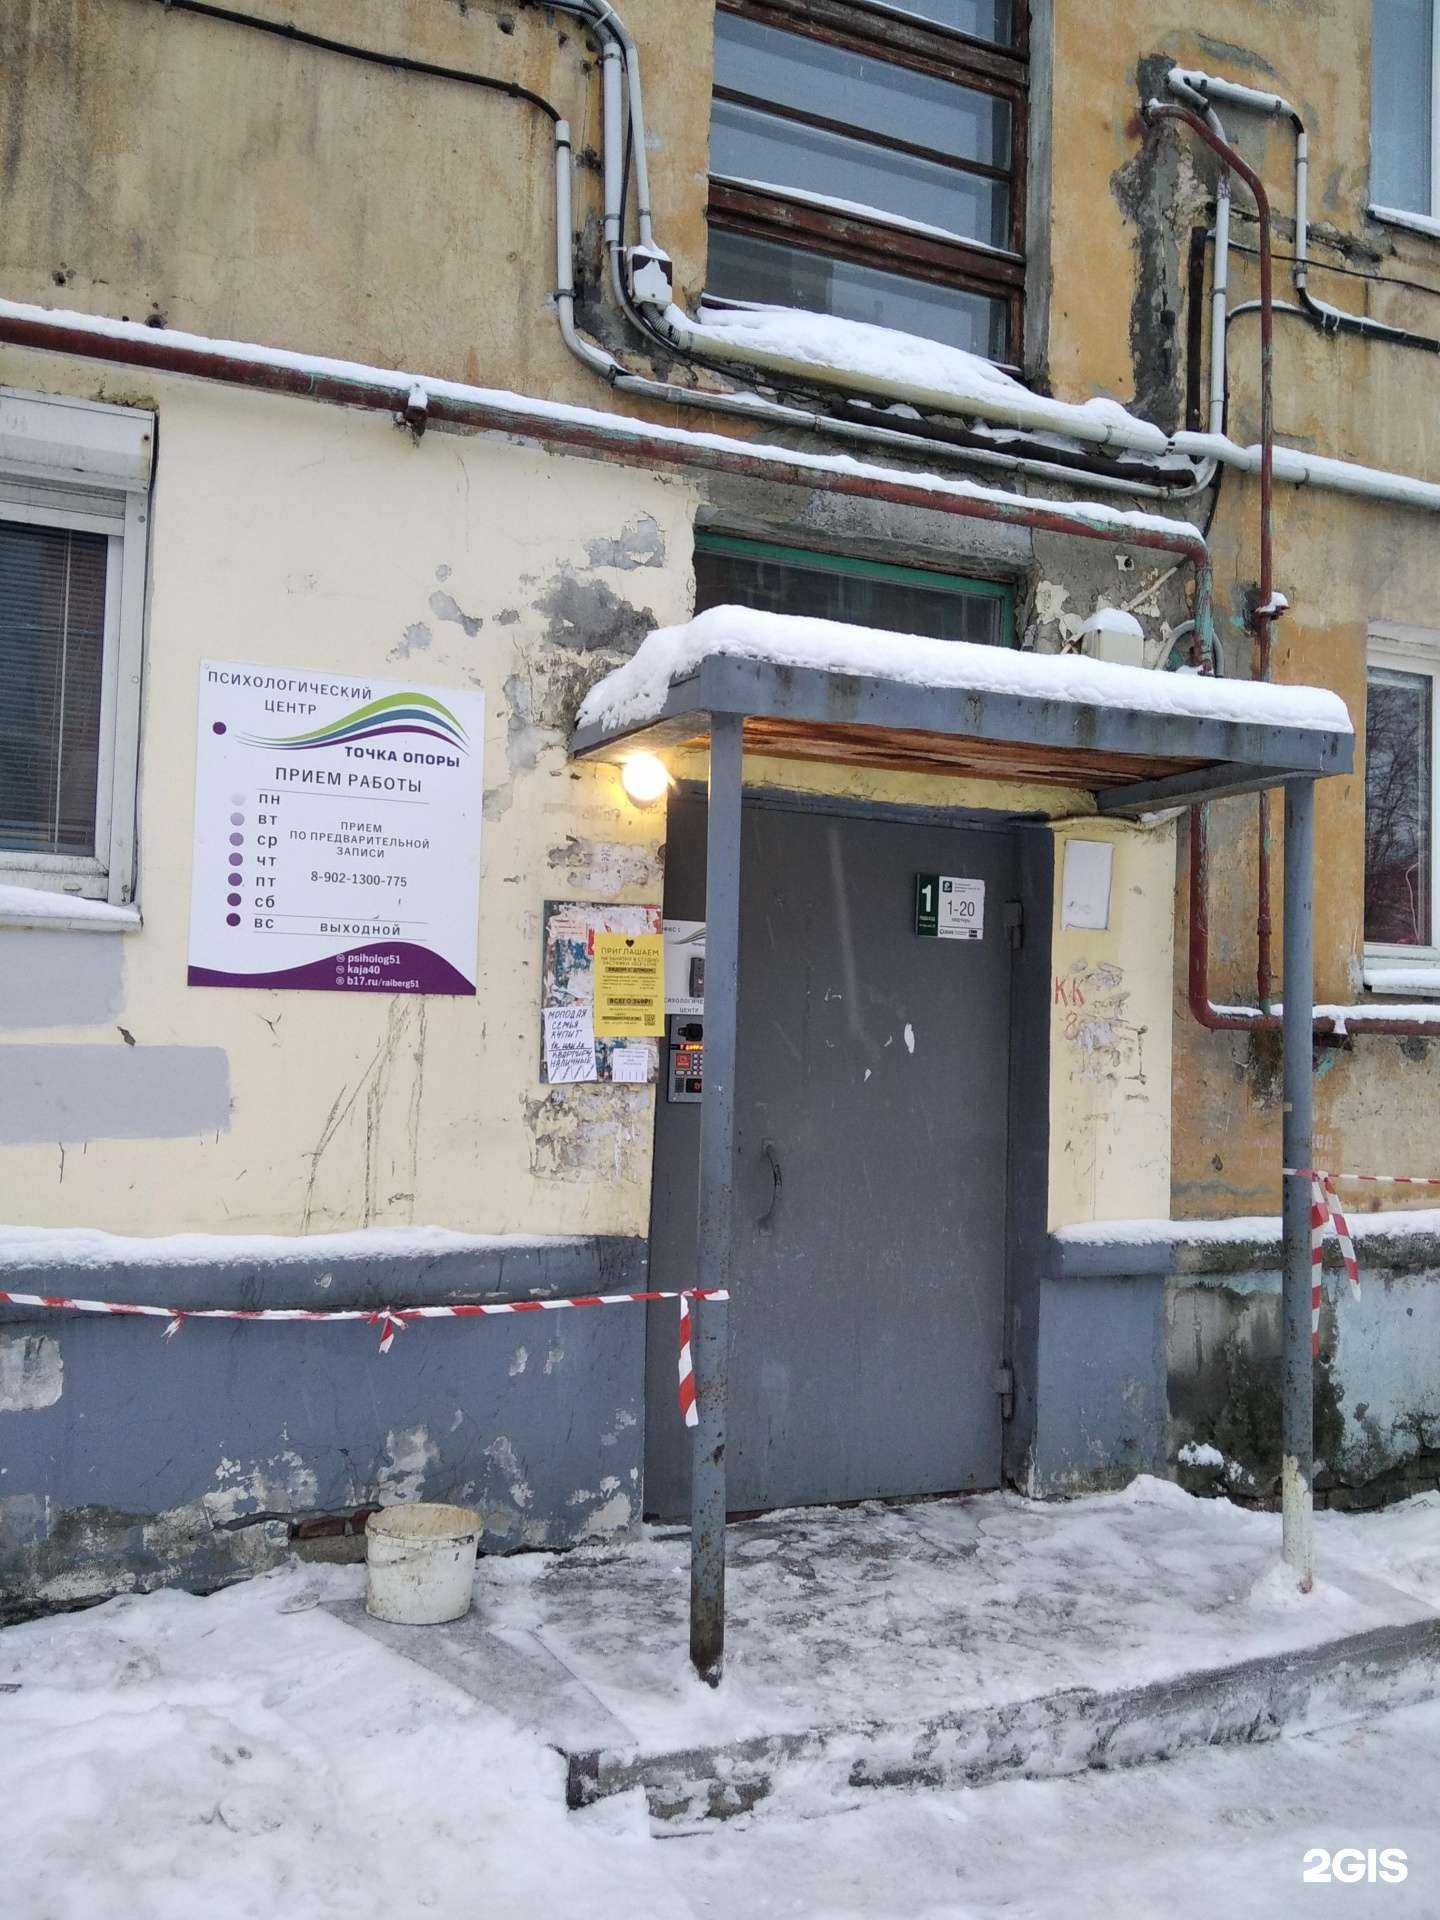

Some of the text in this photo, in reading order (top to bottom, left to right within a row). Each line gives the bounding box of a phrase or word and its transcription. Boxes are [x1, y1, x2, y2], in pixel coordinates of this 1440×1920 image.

[208, 670, 372, 700] ПСИХОЛОГИЧЕСКИЙ
[264, 700, 317, 715] ЦЕНТР
[344, 746, 460, 768] ТОЧКА ОПОРЫ
[275, 767, 422, 793] ПРИЕМ РАБОТЫ
[340, 821, 383, 833] ПРИЕМ
[289, 830, 430, 849] ПО ПРЕДВАРИТЕЛЬНОЙ
[336, 846, 385, 858] ЗАПИСИ
[310, 871, 408, 888] 8-902-1300-775
[921, 884, 932, 913] 1
[947, 900, 975, 917] 1-20
[320, 922, 401, 936] ВЫХОДНОЙ
[601, 946, 660, 957] ПРИГЛАШАЕМ
[347, 953, 401, 966] psiholog51
[347, 963, 381, 976] kaja40
[346, 976, 420, 989] b17.ru/raiberg51
[548, 1008, 588, 1020] МОЛОДАЯ
[551, 1020, 579, 1030] СЕМЬЯ
[551, 1029, 583, 1040] КУПИТ
